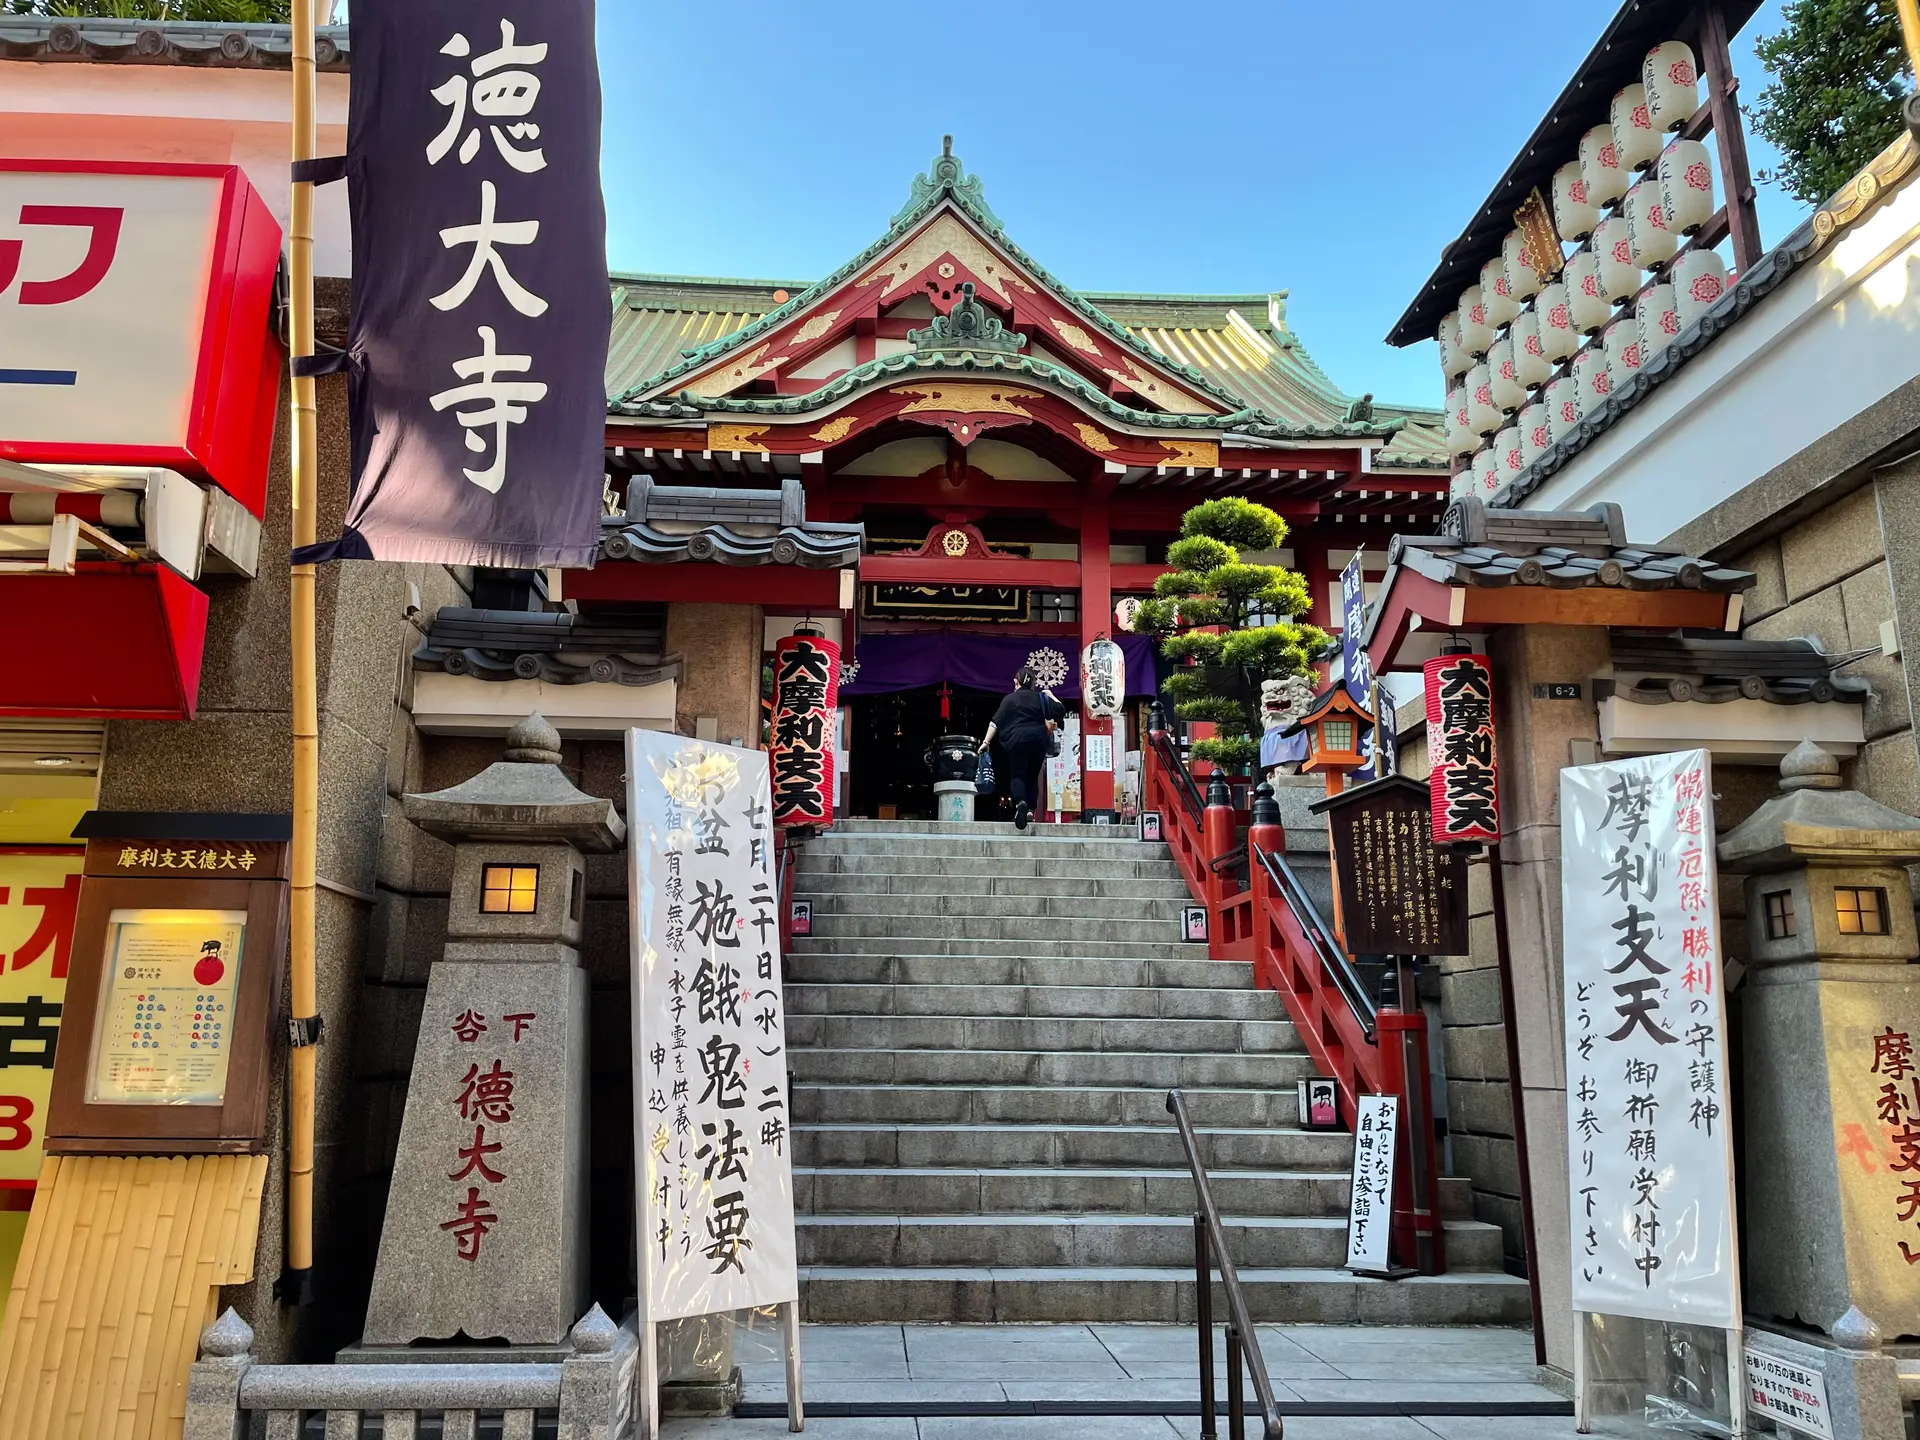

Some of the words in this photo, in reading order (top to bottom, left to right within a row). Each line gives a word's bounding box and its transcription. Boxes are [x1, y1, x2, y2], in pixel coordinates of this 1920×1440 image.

[774, 640, 829, 818] 大摩利支天
[1441, 660, 1498, 832] 大摩利支天
[1555, 686, 1575, 696] 6-2
[1374, 1101, 1395, 1206] お上りになって
